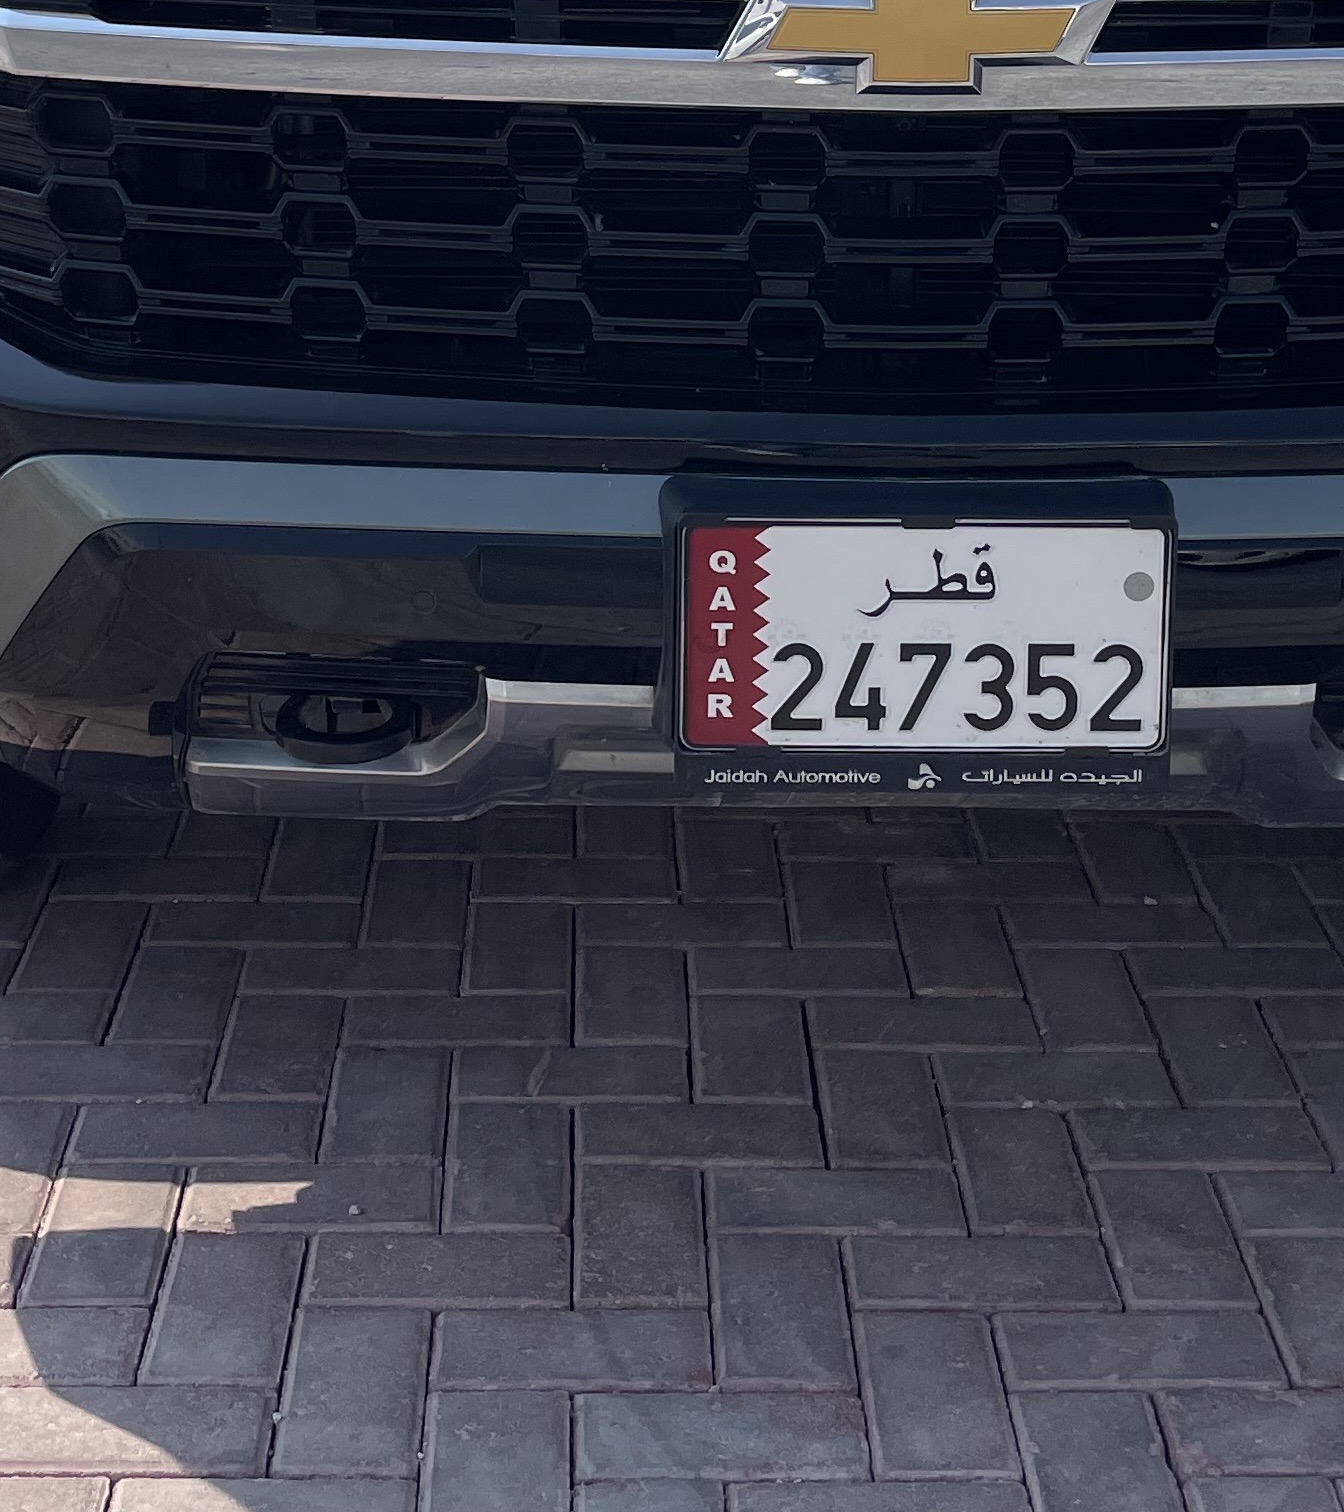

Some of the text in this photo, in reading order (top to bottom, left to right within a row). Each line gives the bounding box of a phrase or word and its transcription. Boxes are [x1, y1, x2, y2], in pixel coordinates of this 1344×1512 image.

[857, 543, 997, 618] قطر
[706, 550, 737, 719] QATAR
[769, 642, 1145, 732] 247352
[704, 768, 881, 784] Jaidah Automotive
[961, 768, 1054, 785] للسيارات
